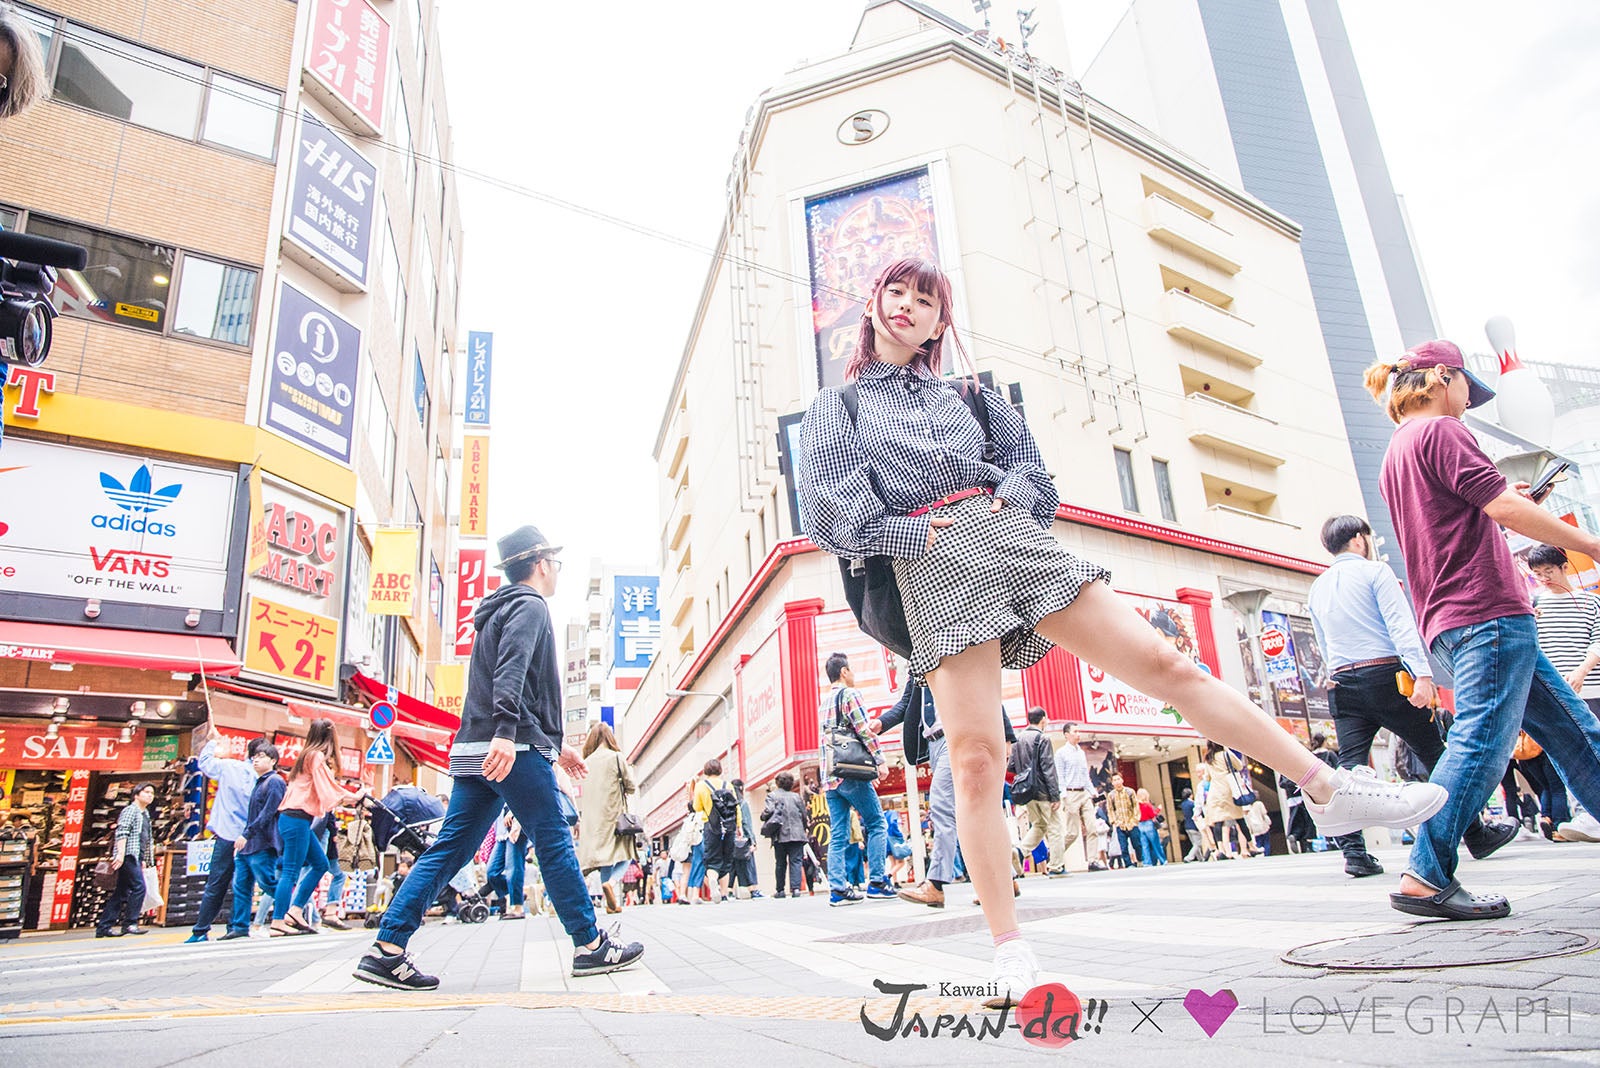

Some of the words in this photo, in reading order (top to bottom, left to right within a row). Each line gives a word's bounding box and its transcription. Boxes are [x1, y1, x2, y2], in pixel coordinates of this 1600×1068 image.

[352, 9, 380, 111] 発毛専門
[306, 184, 359, 233] 海外旅行
[304, 201, 357, 249] 国内旅行
[470, 337, 487, 410] レオパレス21
[303, 422, 319, 436] 3F
[91, 514, 176, 537] adidas
[266, 503, 337, 563] ABC
[90, 546, 173, 578] VANS
[260, 551, 335, 597] MART
[108, 579, 135, 589] THE
[373, 573, 411, 590] ABC
[371, 590, 410, 603] MART
[256, 601, 334, 638] スニーカー
[293, 638, 326, 681] 2F
[437, 696, 462, 707] ABC
[1110, 693, 1129, 714] VR
[1127, 694, 1150, 704] PARK
[1129, 706, 1157, 716] TOKYO
[22, 735, 121, 760] SALE
